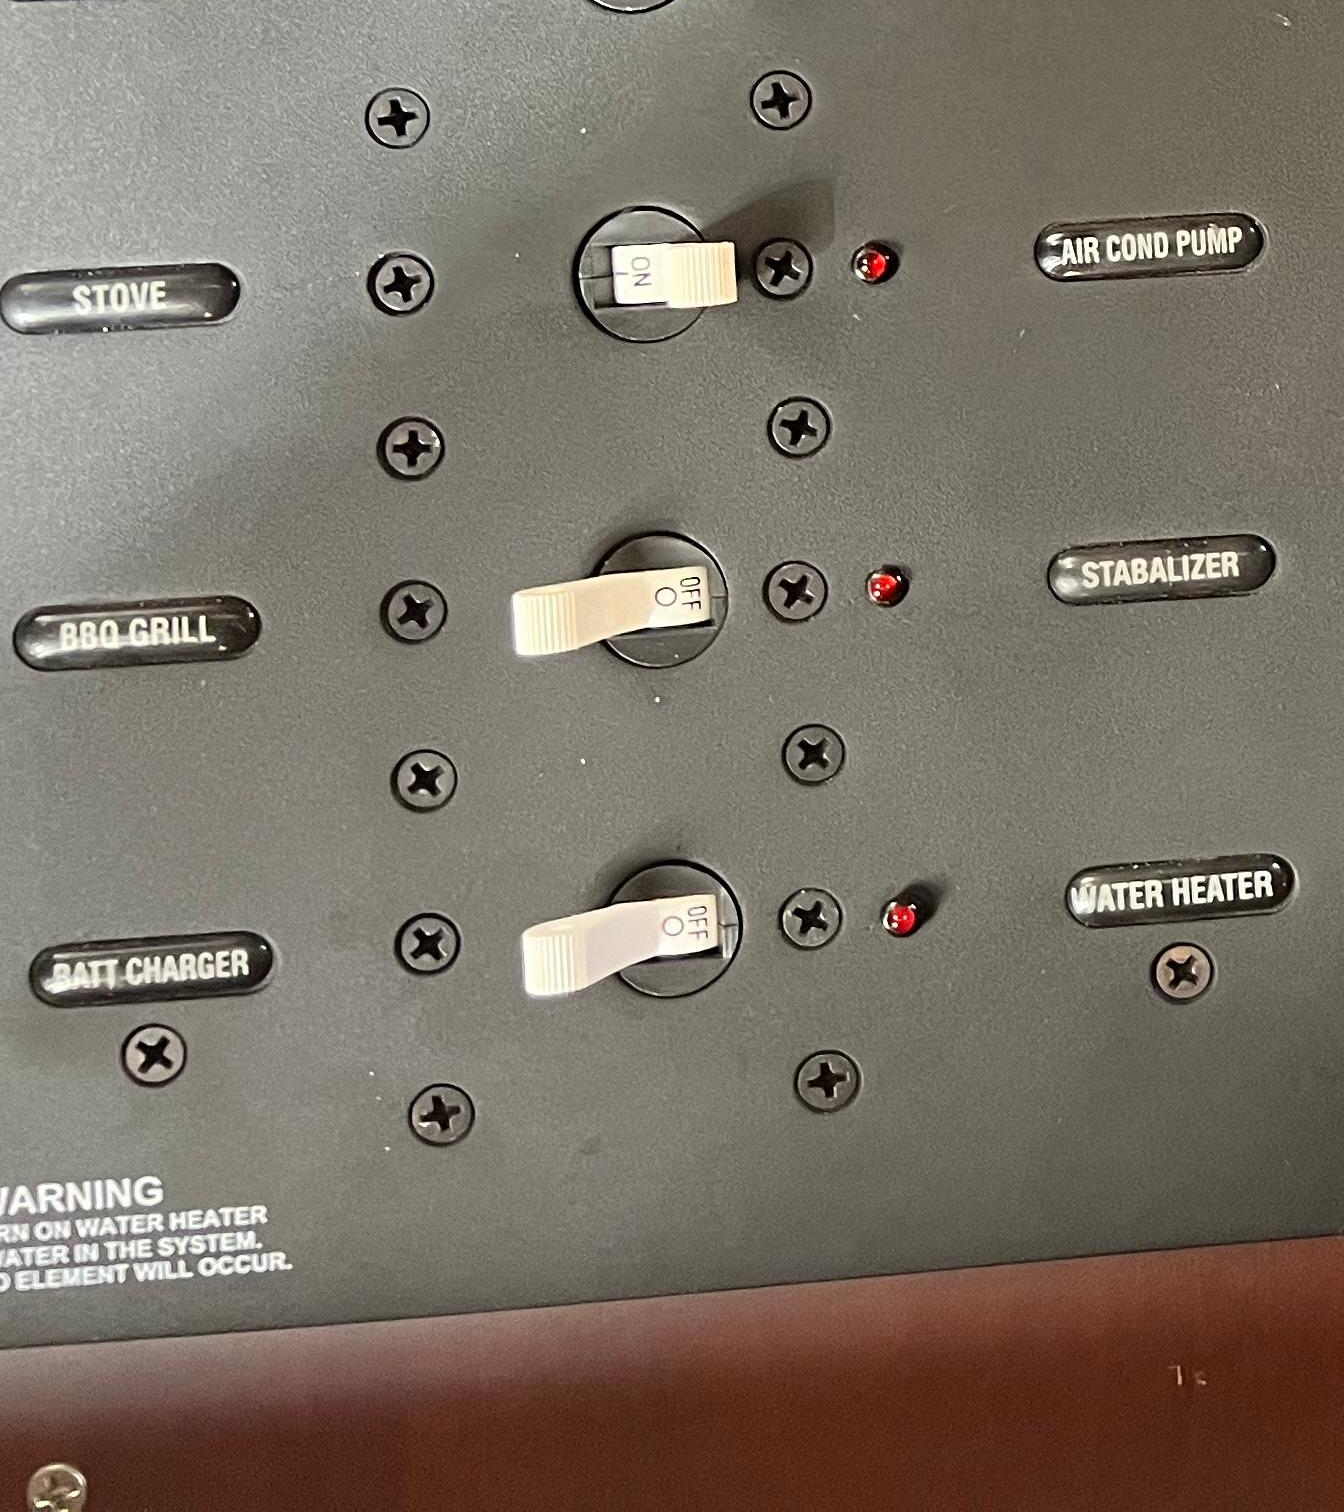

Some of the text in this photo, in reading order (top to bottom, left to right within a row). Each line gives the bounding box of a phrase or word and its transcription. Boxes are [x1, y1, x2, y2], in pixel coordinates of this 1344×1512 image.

[1061, 226, 1243, 266] AIR COND PUMP
[631, 256, 652, 287] ON
[73, 281, 167, 315] STOVE
[1081, 550, 1240, 589] STABALIZER
[679, 576, 702, 610] OFF
[60, 616, 216, 650] BBQ GRILL
[1071, 870, 1274, 914] WATER HEATER
[687, 905, 709, 940] OFF
[52, 949, 249, 990] BATT CHARGER
[33, 1220, 72, 1242] ON
[75, 1214, 163, 1238] WATER
[169, 1205, 268, 1229] HEATER
[73, 1243, 99, 1264] IN
[103, 1238, 152, 1261] THE
[157, 1231, 262, 1256] SYSTEM.
[15, 1263, 130, 1292] ELEMENT
[132, 1259, 193, 1283] WILL
[198, 1252, 293, 1277] OCCUR.
